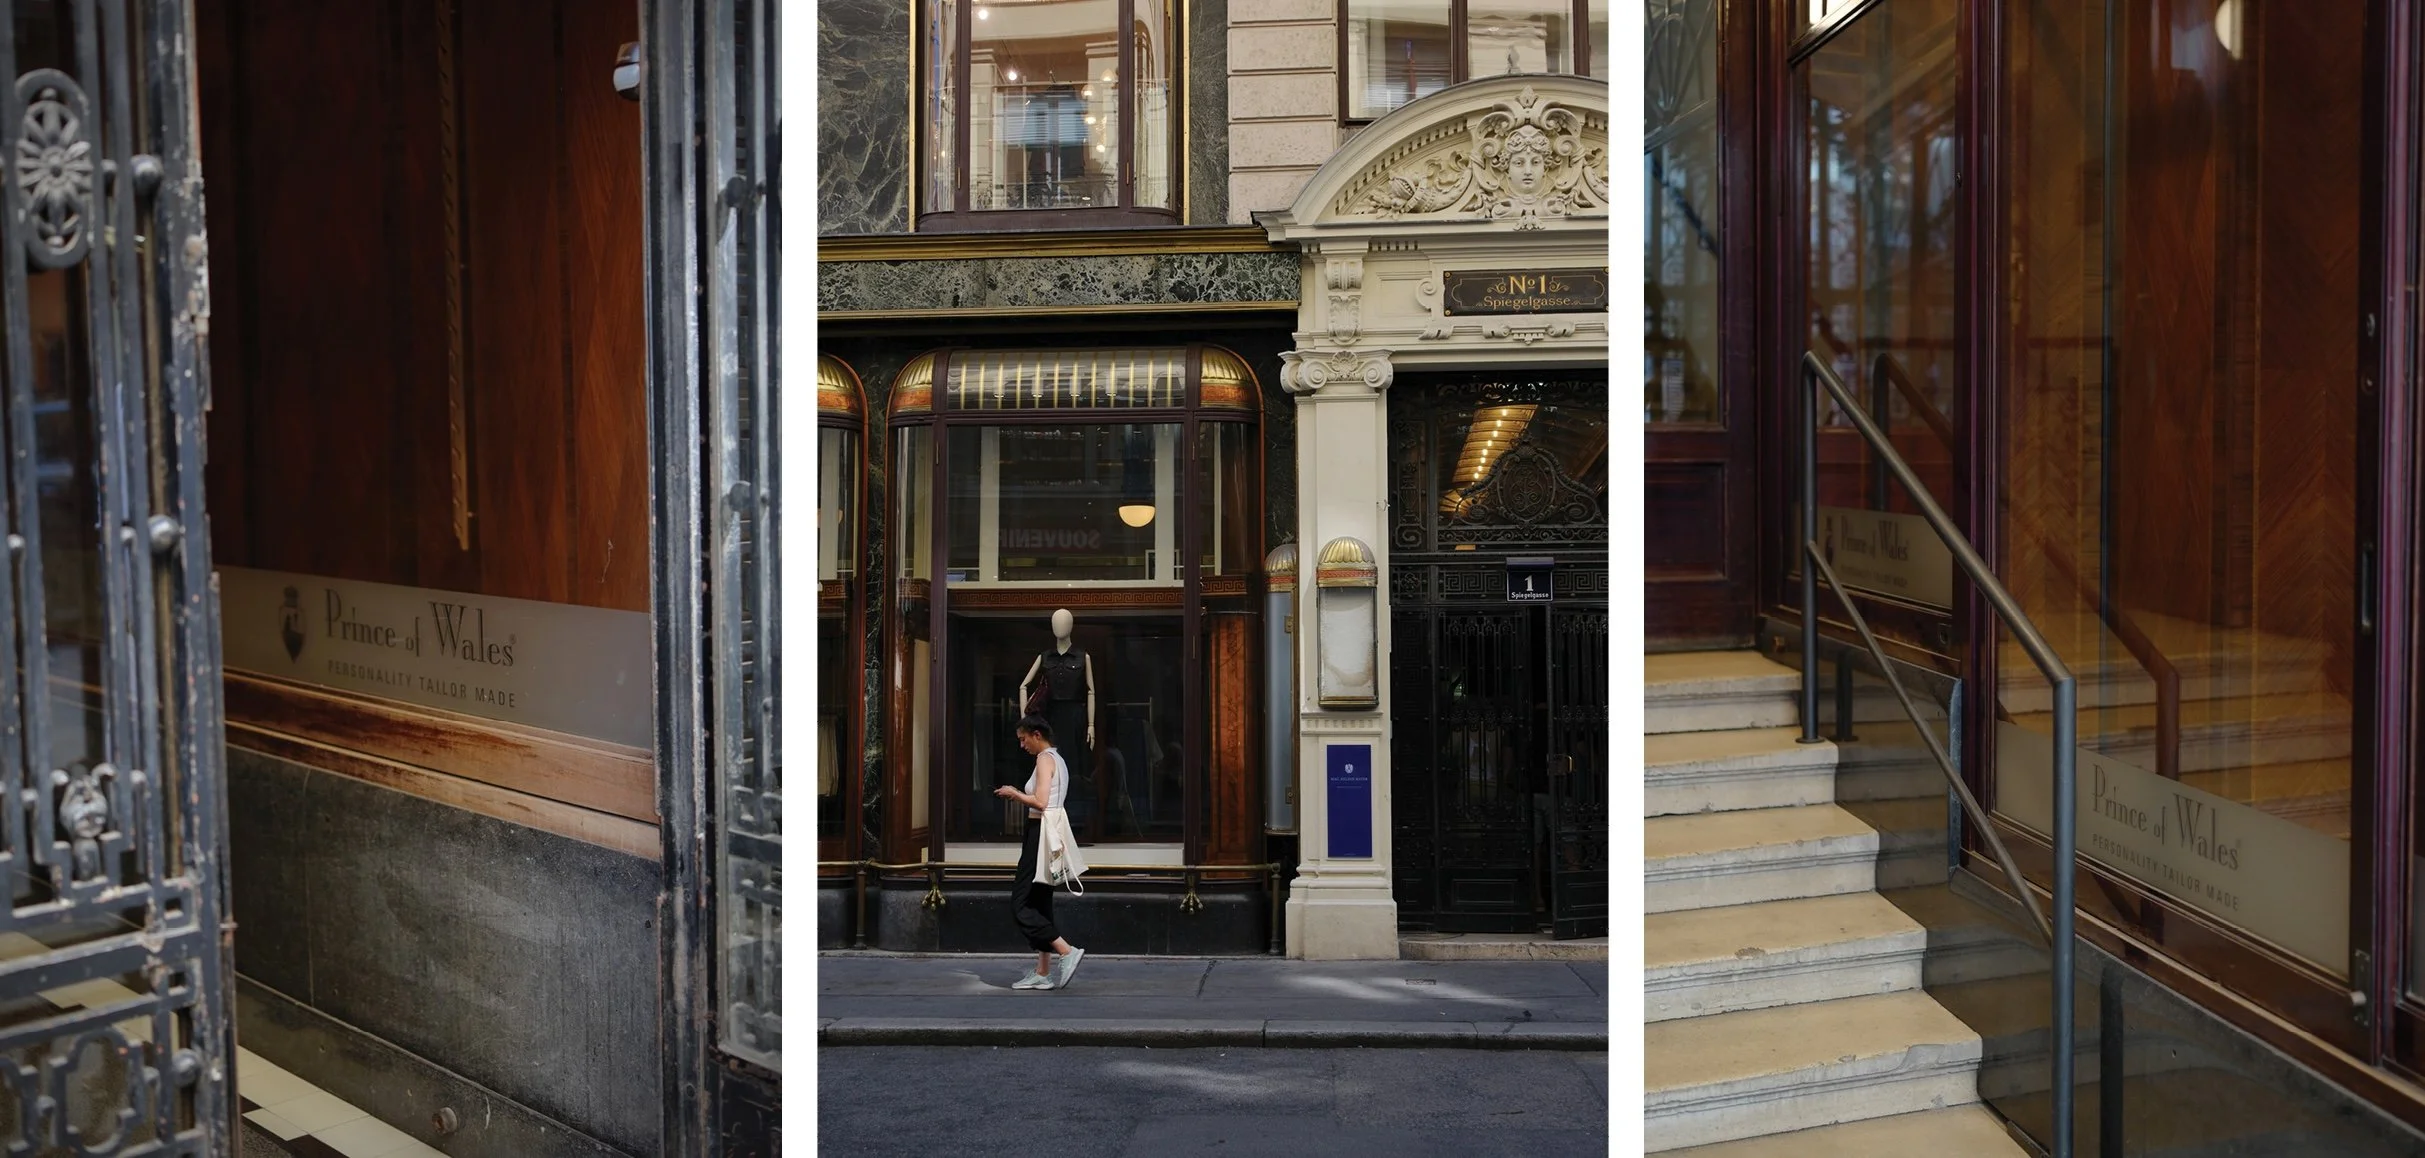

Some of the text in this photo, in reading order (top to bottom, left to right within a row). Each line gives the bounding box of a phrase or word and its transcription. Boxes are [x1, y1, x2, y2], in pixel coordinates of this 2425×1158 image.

[1483, 296, 1571, 310] Spiegelgasse
[1524, 575, 1534, 591] 1
[325, 588, 397, 648] Prince
[405, 616, 420, 657] of
[328, 660, 516, 708] PERSONALITY TAILOR MADE
[2093, 763, 2239, 871] Prince of Wales
[2092, 833, 2239, 911] PERSONALITY TAILOR MADE
